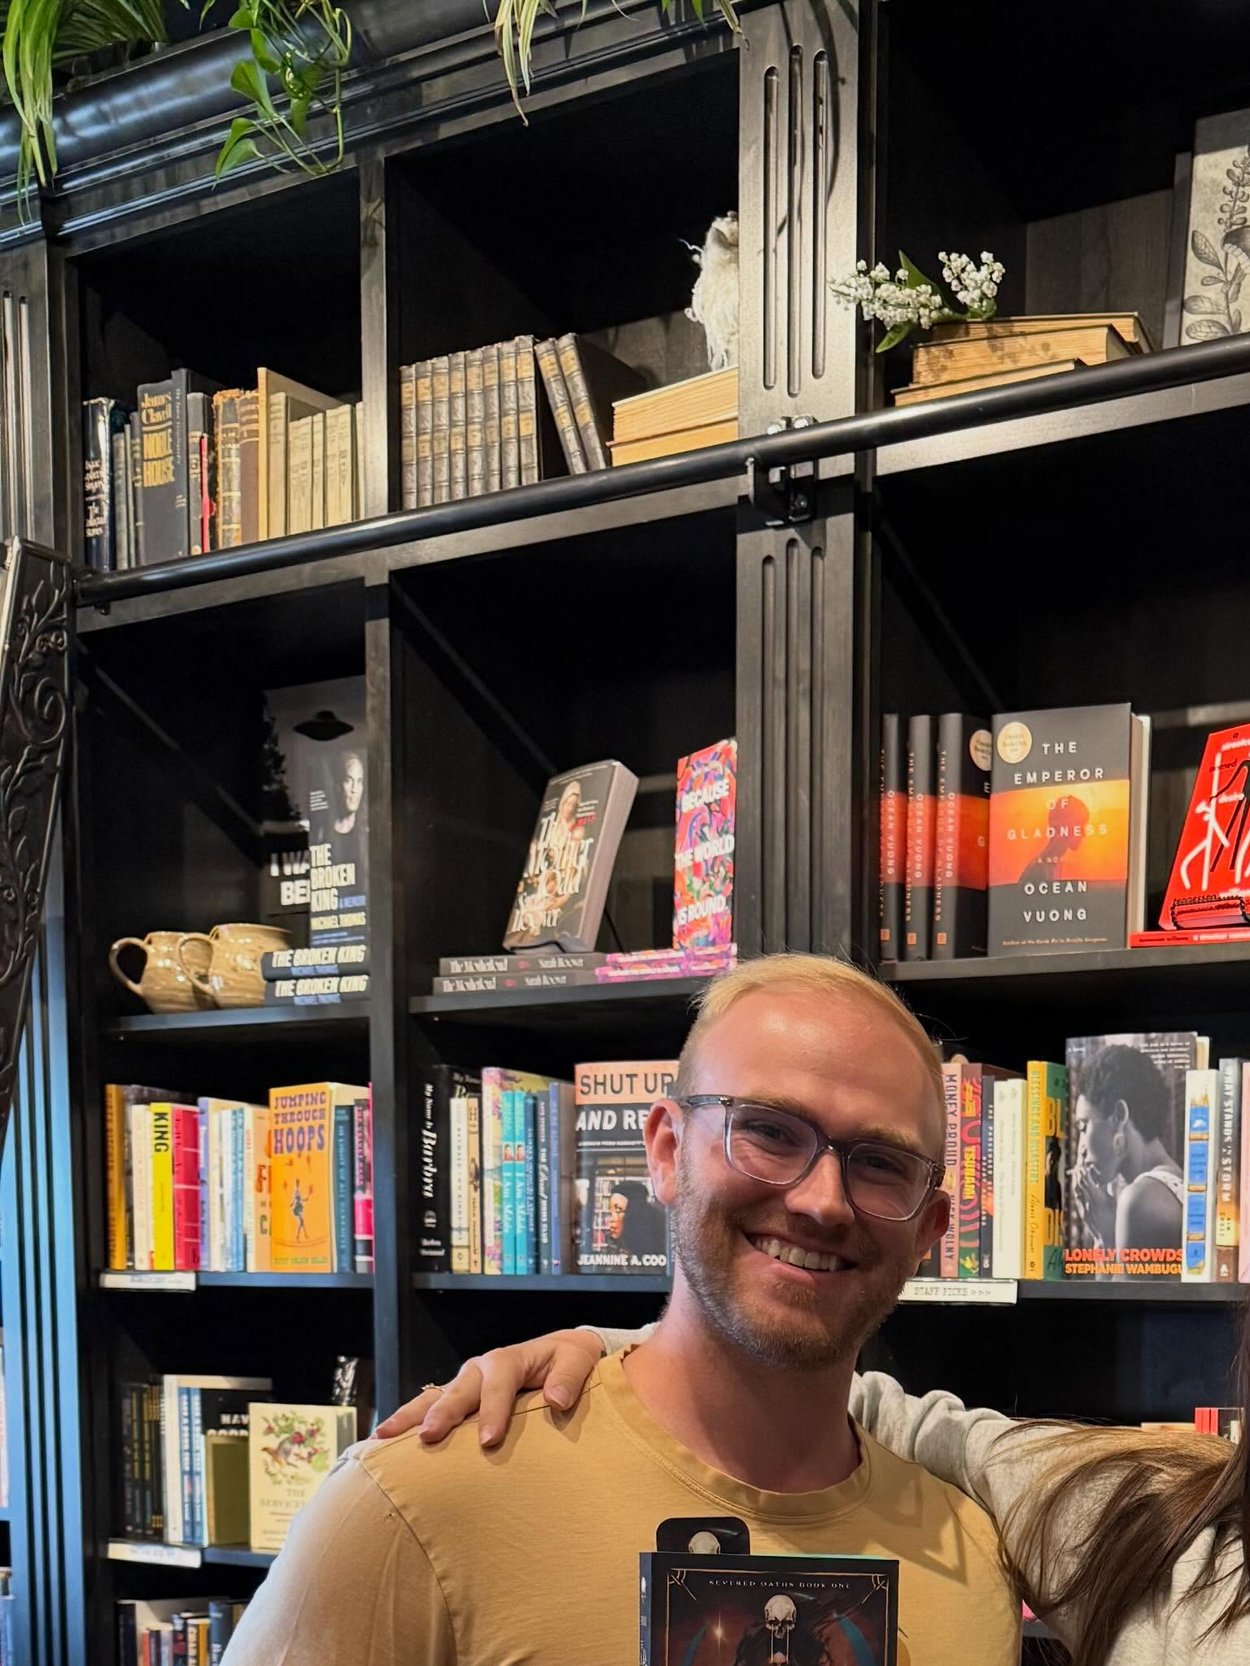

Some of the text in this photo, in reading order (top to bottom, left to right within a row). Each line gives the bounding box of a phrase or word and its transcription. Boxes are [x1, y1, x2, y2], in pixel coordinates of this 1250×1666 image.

[1041, 740, 1078, 756] THE
[1012, 766, 1105, 786] EMPEROR
[680, 780, 731, 811] BECAUSE
[1046, 798, 1070, 811] OF
[1006, 823, 1109, 842] GLADNESS
[309, 844, 332, 867] THE
[693, 833, 735, 862] WORLD
[310, 862, 356, 890] BROKEN
[1023, 880, 1088, 896] OCEAN
[310, 887, 339, 912] KING
[1022, 907, 1088, 923] VUONG
[579, 1073, 675, 1097] SHUT UP
[274, 1091, 327, 1110] JUMPING
[274, 1108, 326, 1125] THROUGH
[576, 1110, 617, 1132] AND
[153, 1111, 169, 1154] KING
[273, 1123, 326, 1155] HOOPS
[946, 1122, 957, 1167] PROUD
[421, 1129, 438, 1199] Barbra
[962, 1145, 976, 1200] TSUNAMI
[577, 1253, 628, 1267] JEANNINE
[1065, 1247, 1183, 1262] LONELY CROWDS
[1065, 1263, 1124, 1275] STEPHANIE
[708, 1579, 757, 1588] SEVERED
